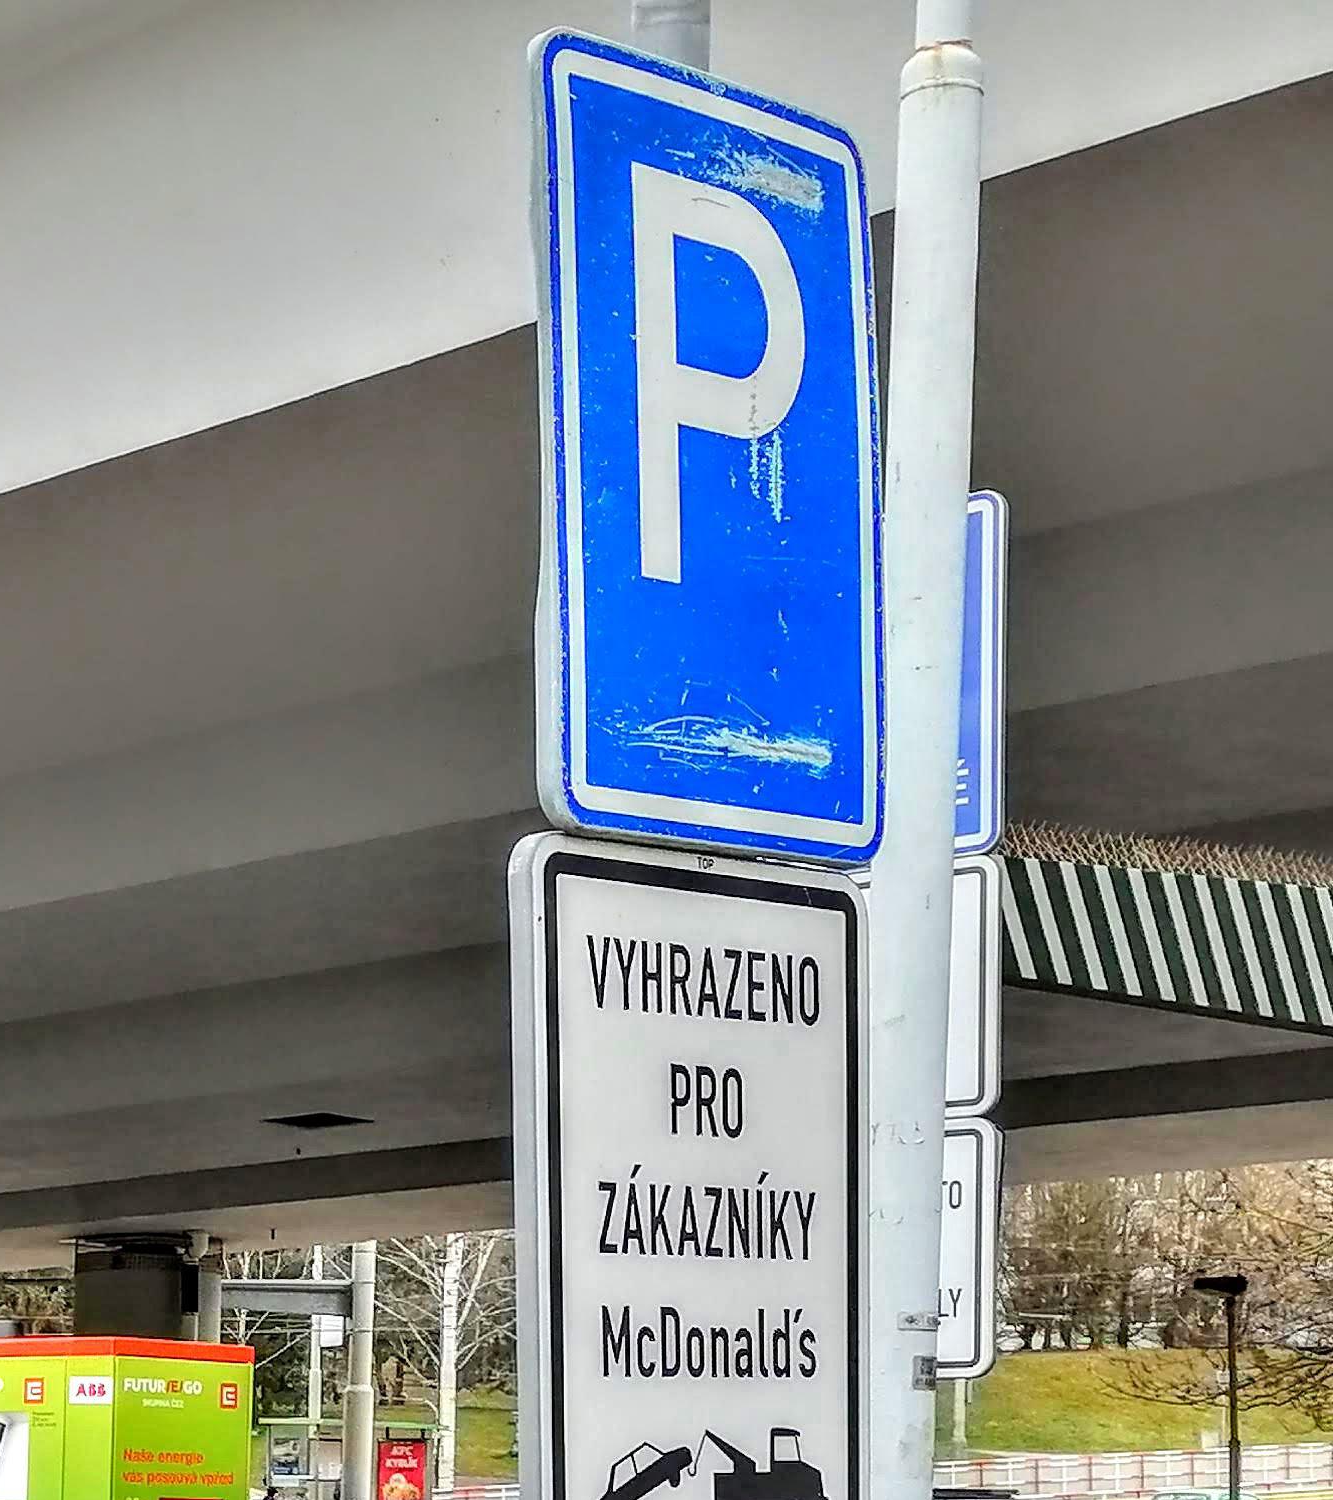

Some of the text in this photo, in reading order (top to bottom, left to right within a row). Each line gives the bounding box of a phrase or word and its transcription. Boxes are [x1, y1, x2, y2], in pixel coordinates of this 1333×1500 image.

[630, 161, 806, 585] P
[586, 935, 821, 1026] VYHRAZENO
[669, 1063, 744, 1139] PRO
[597, 1164, 817, 1261] ZÁKAZNÍKY
[76, 1383, 106, 1397] ABB
